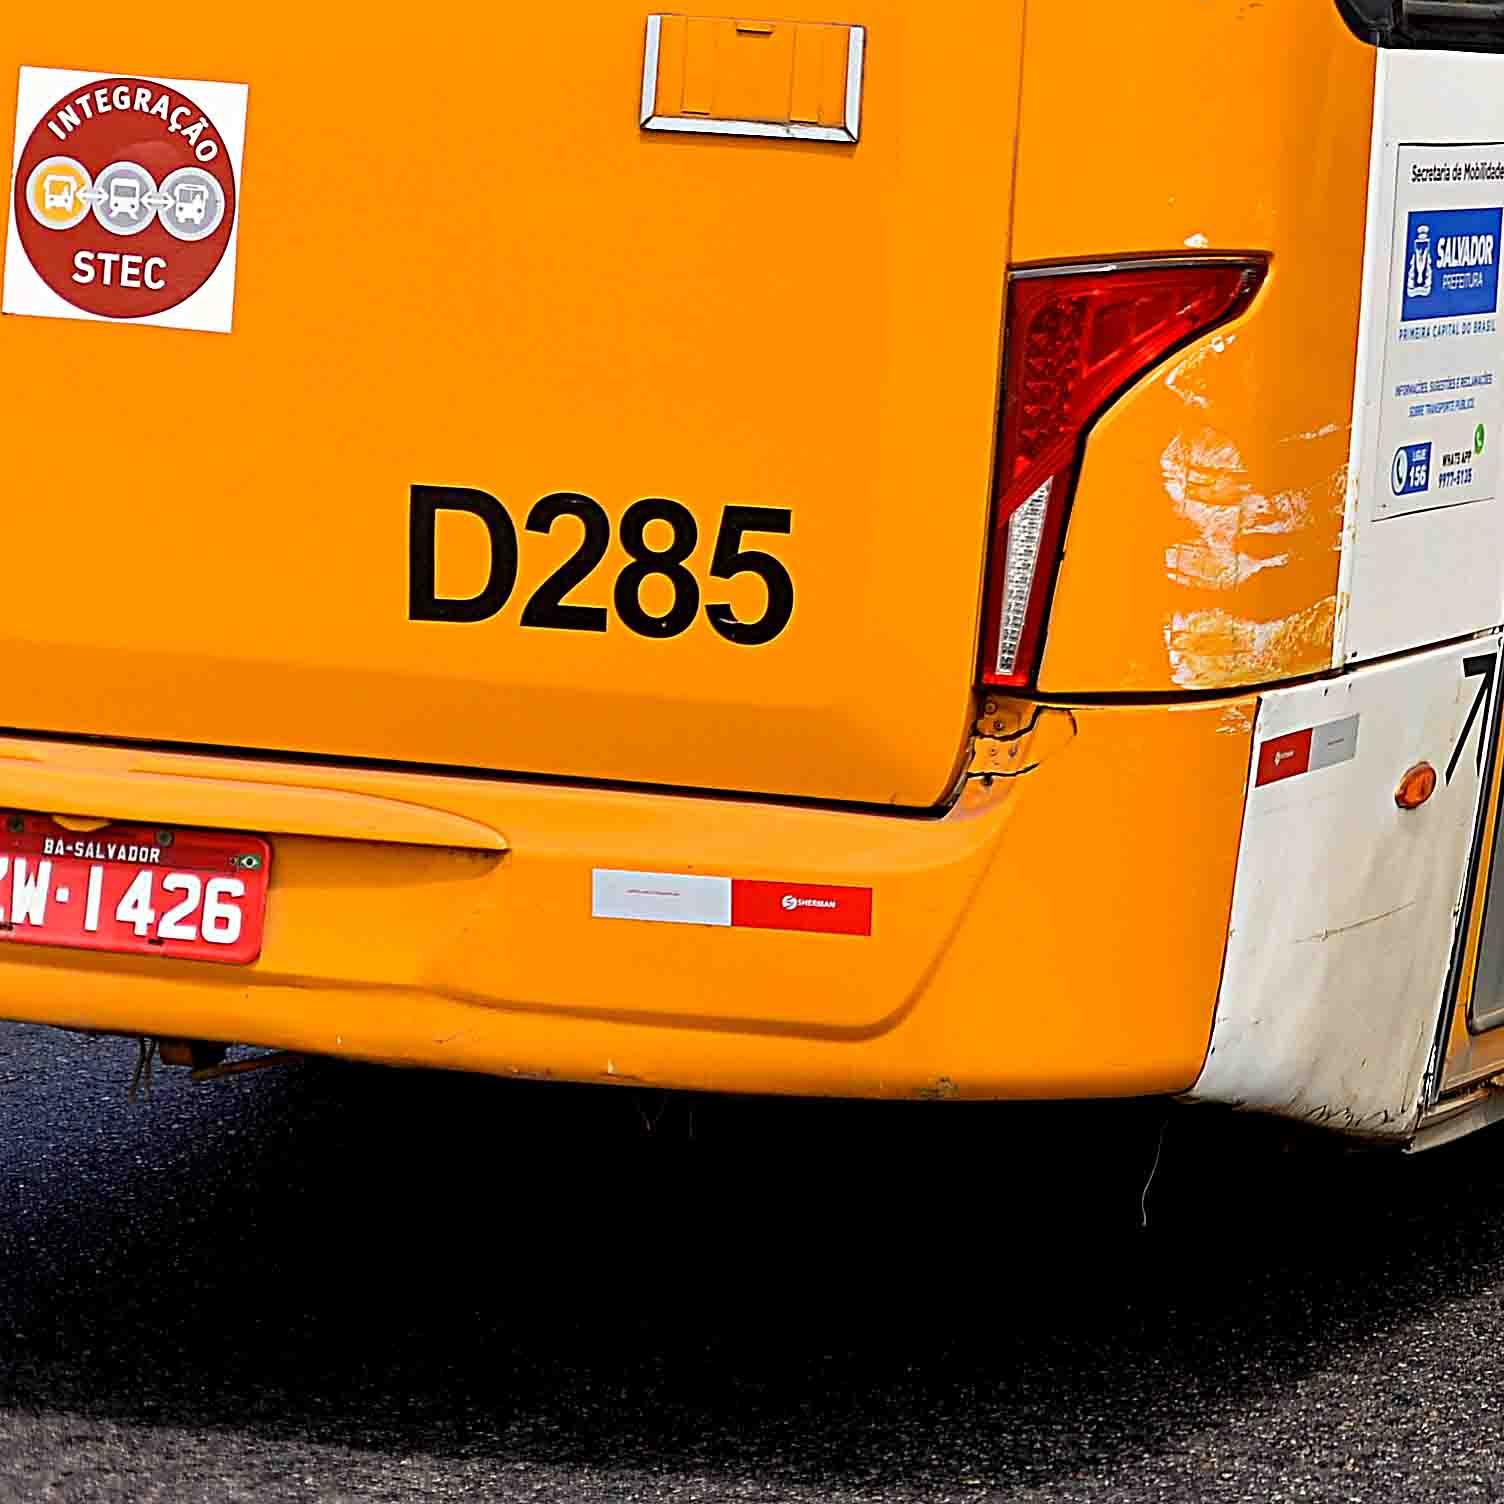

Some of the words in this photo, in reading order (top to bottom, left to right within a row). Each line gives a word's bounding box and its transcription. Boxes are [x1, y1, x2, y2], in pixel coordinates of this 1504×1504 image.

[46, 85, 218, 165] INTEGRAÇÃO
[1411, 163, 1450, 182] Secretaria
[1452, 163, 1462, 181] de
[1463, 162, 1504, 181] Mobilidade
[1436, 234, 1494, 269] SALVADOR
[72, 251, 169, 291] STEC
[1442, 272, 1483, 289] PREFEITURA
[1473, 319, 1496, 334] BRASIL
[1409, 463, 1428, 487] 156
[407, 483, 796, 647] D285
[43, 837, 161, 864] BA-SALVADOR
